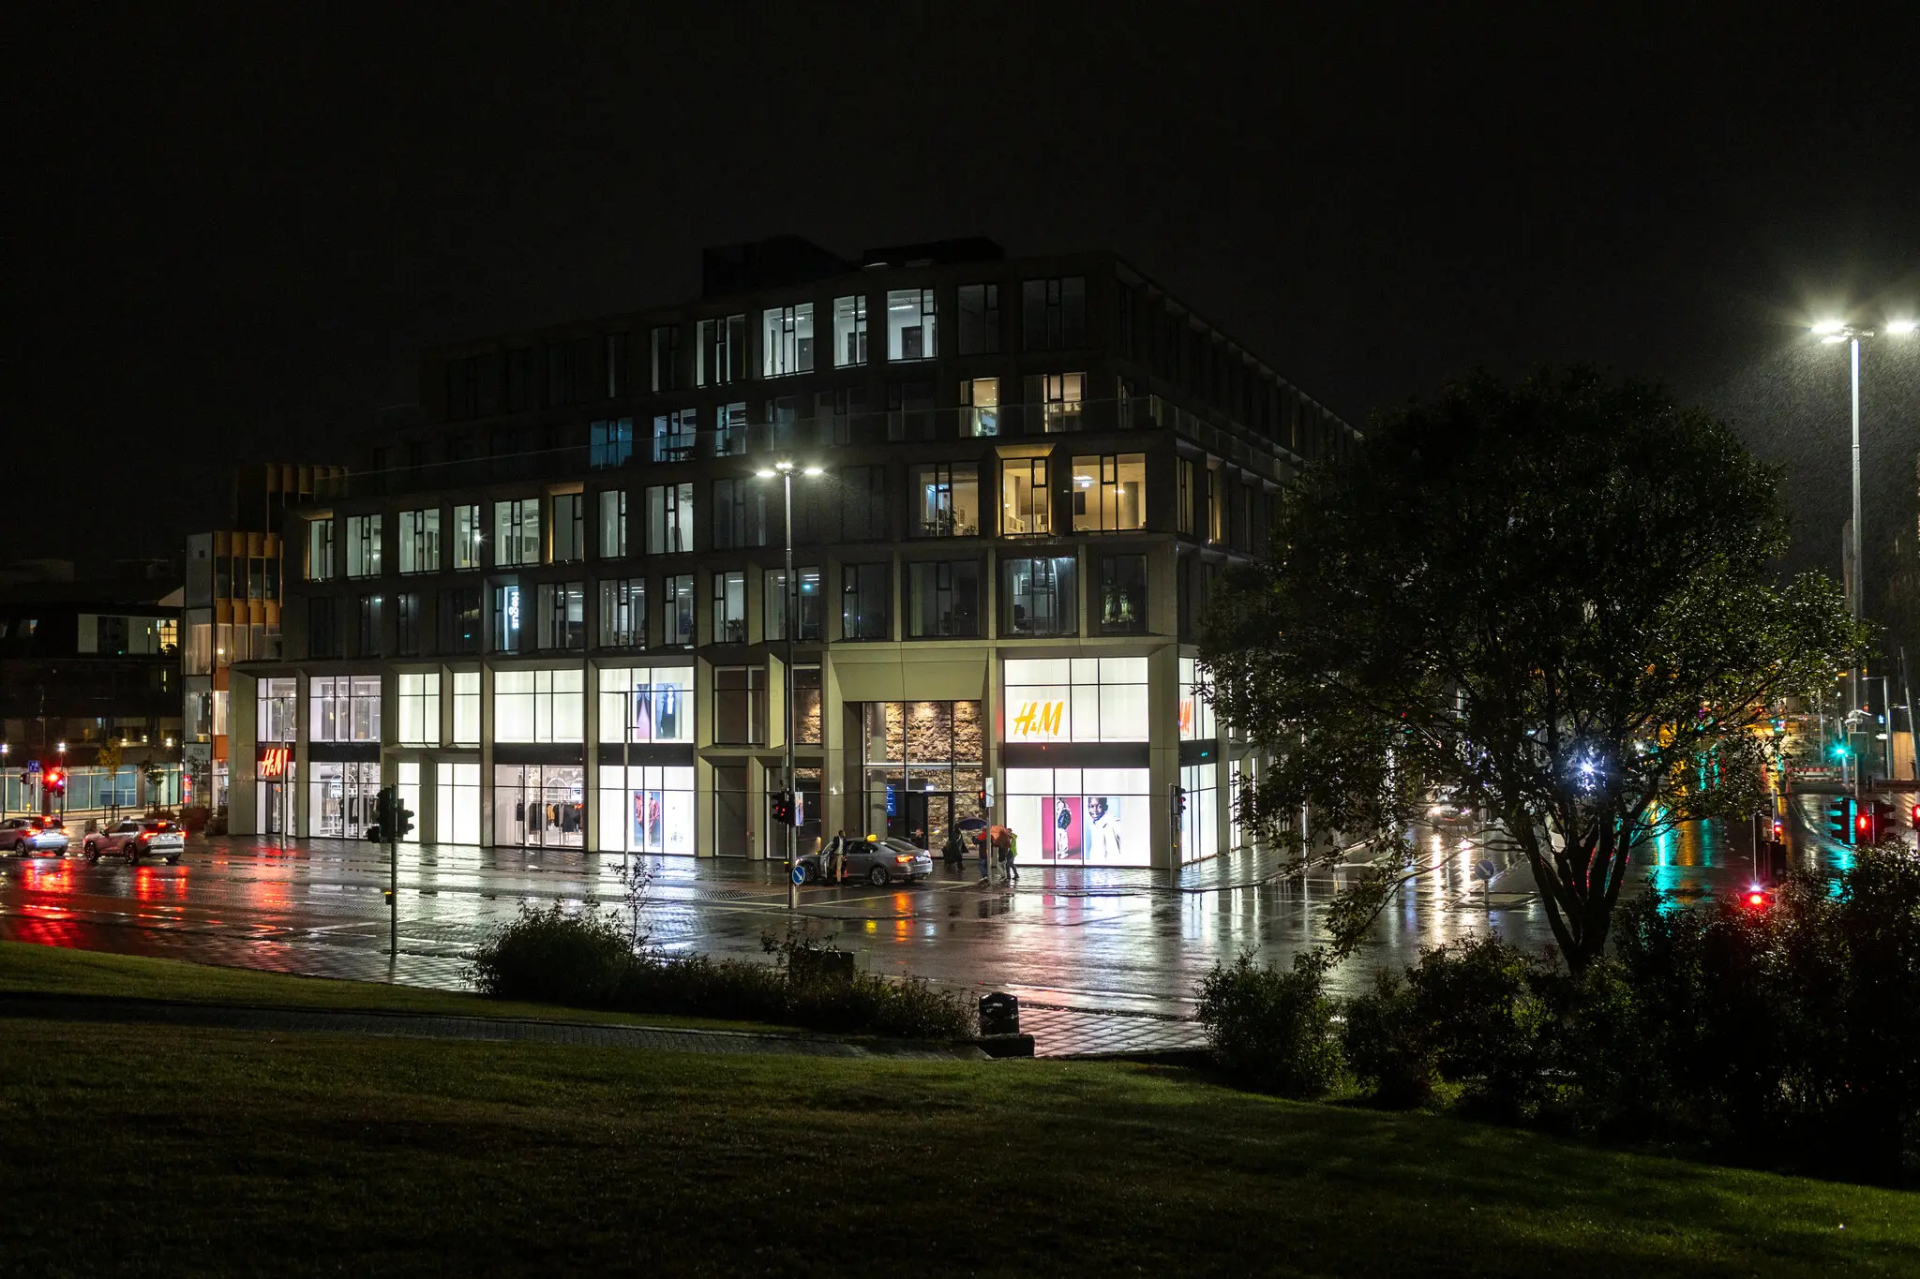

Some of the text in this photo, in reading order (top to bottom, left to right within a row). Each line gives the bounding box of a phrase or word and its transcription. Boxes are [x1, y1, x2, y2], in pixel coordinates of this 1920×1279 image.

[508, 592, 519, 629] regus
[1014, 701, 1062, 736] H&M
[262, 748, 288, 777] H&M
